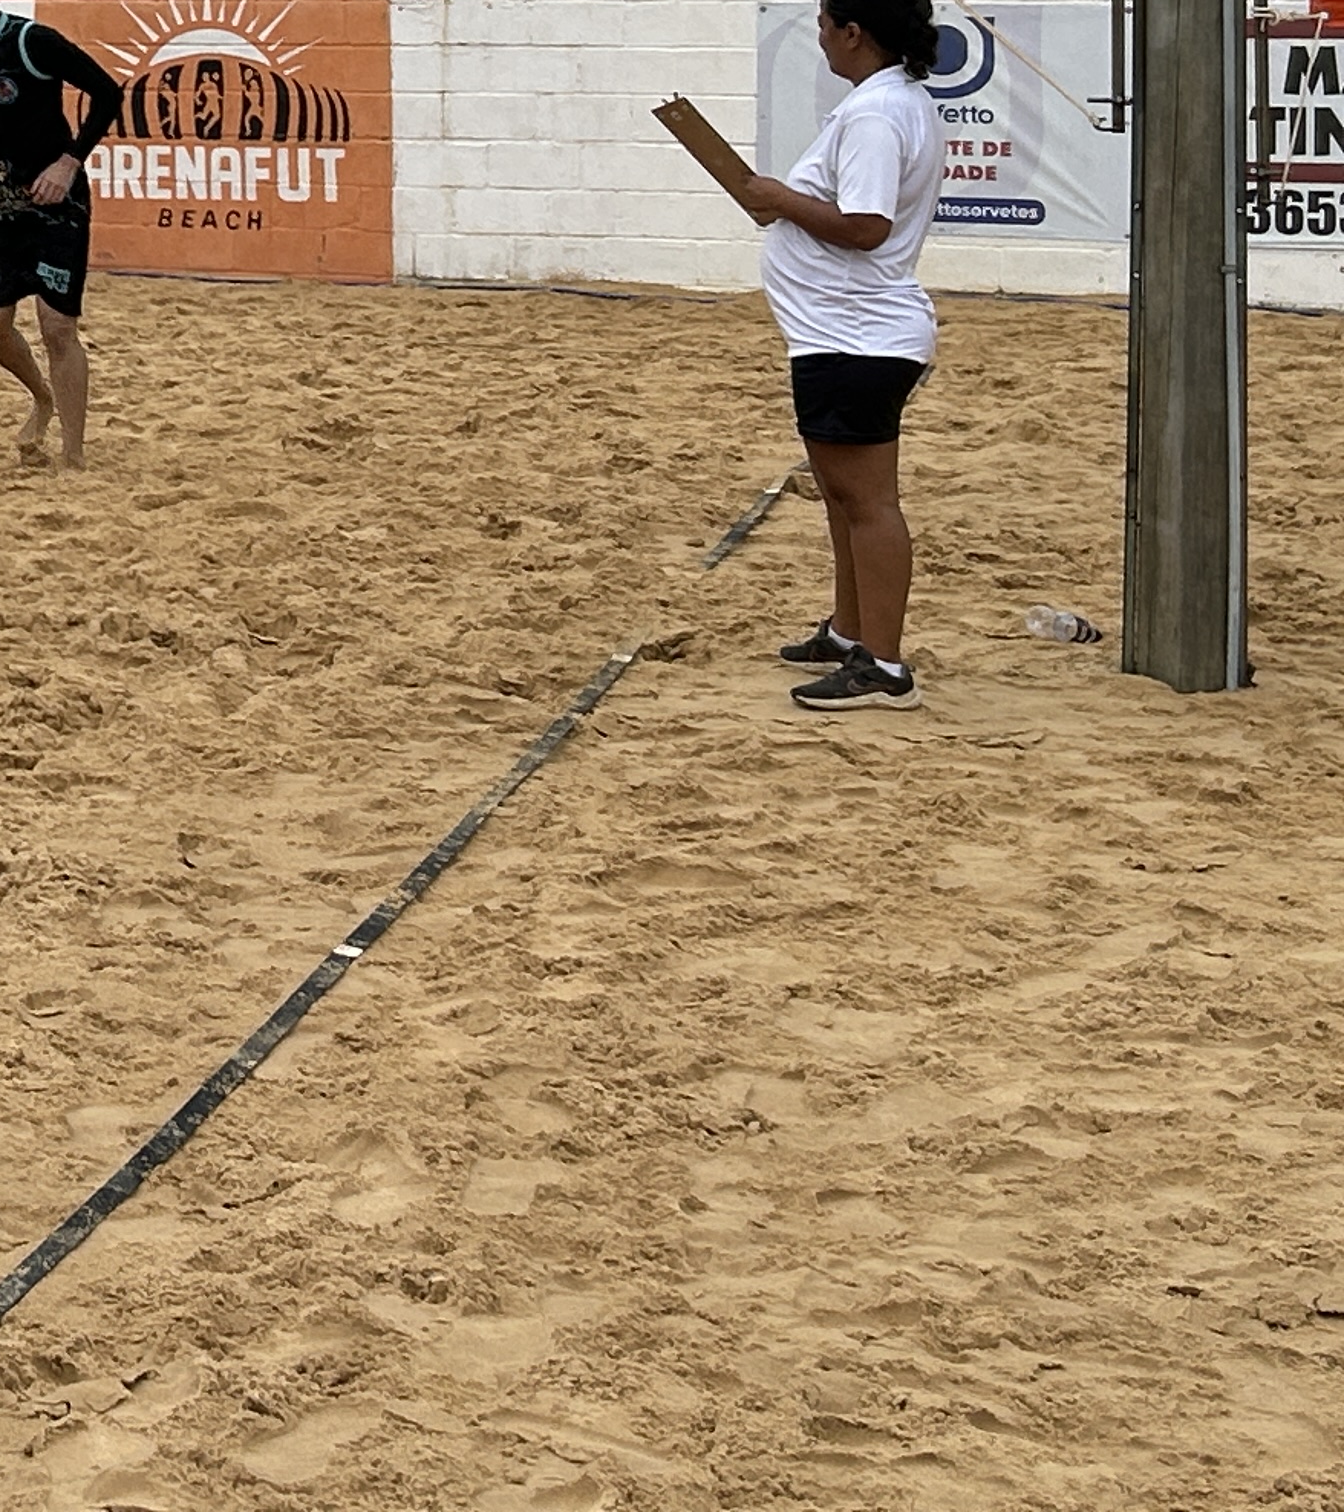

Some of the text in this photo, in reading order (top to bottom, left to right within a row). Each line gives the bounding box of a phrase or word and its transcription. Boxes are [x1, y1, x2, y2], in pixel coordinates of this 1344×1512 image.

[1283, 45, 1344, 95] M
[944, 140, 1012, 157] TE DE
[88, 144, 346, 204] ARENAFUT
[157, 207, 264, 232] BEACH
[1247, 190, 1344, 236] 365
